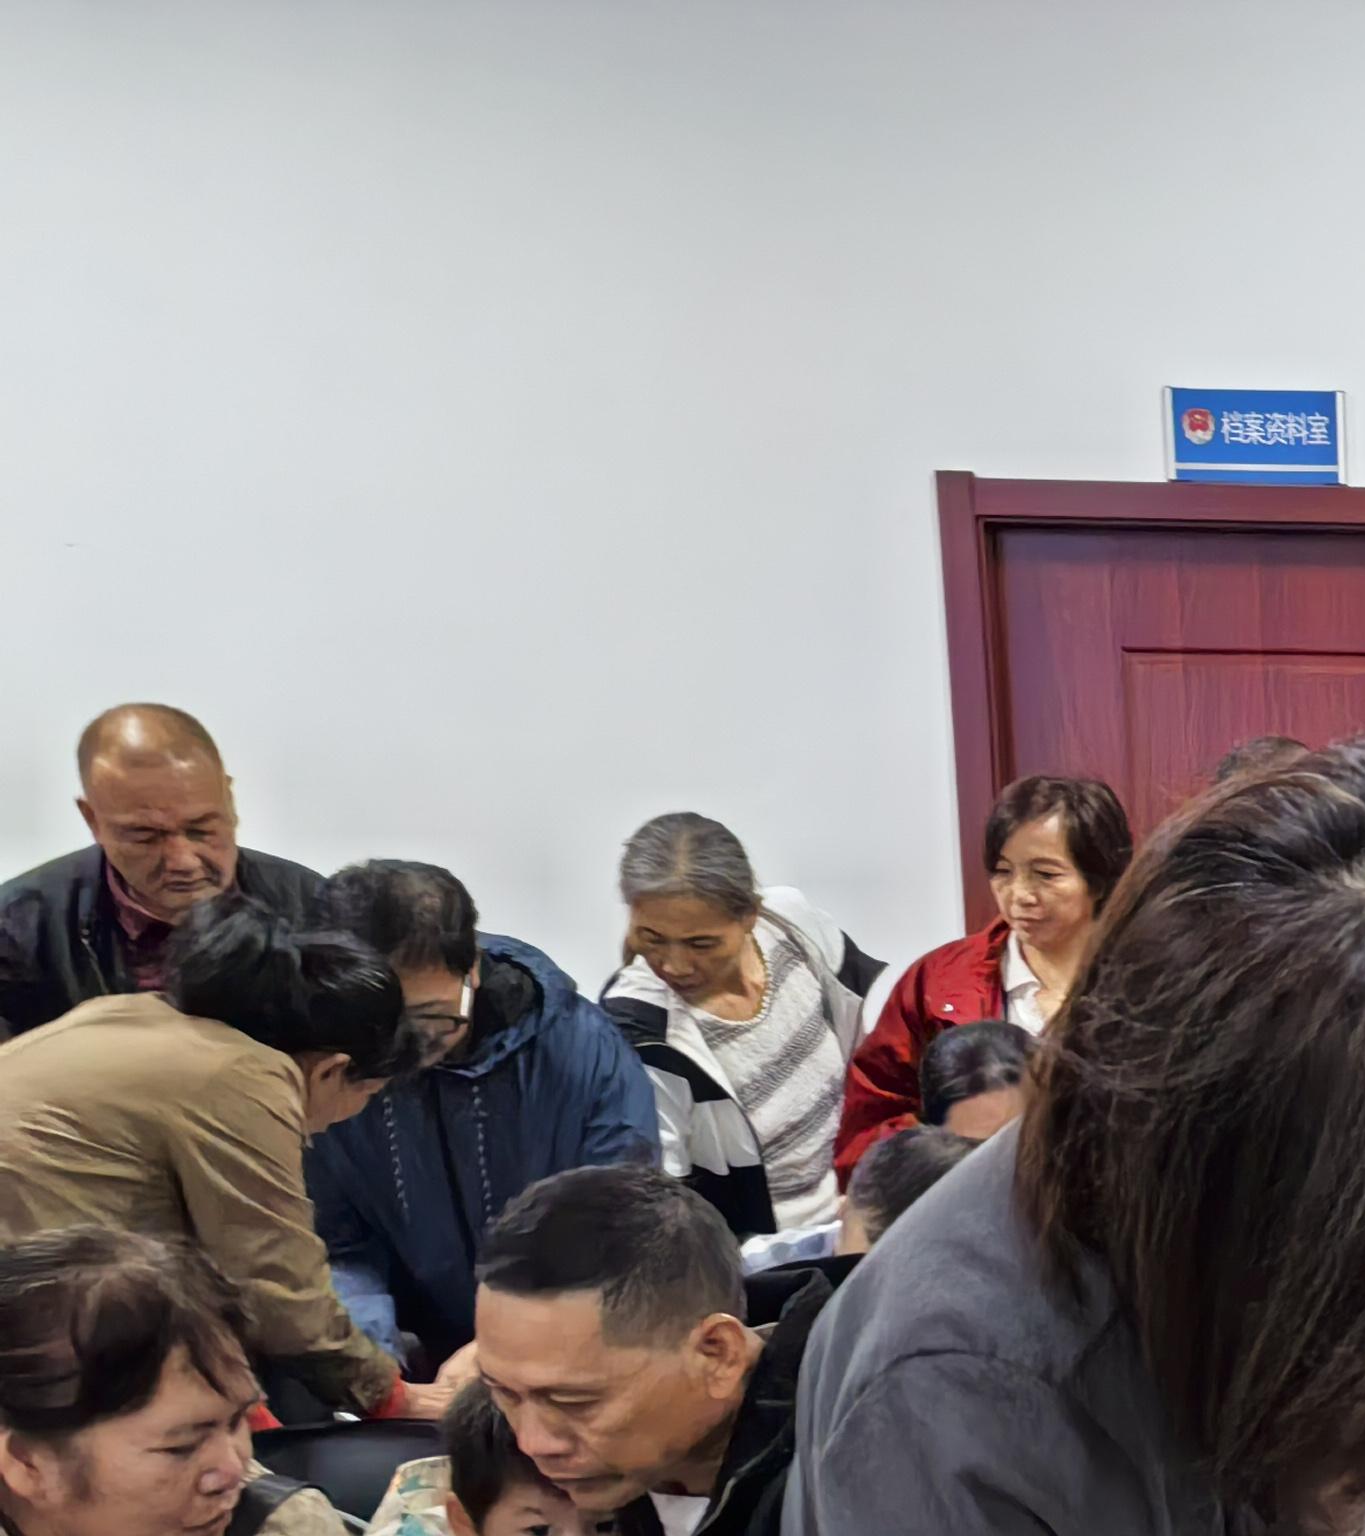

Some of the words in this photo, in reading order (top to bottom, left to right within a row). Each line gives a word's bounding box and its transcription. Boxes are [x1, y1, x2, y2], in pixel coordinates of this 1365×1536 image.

[1220, 410, 1331, 446] 档案资料室
